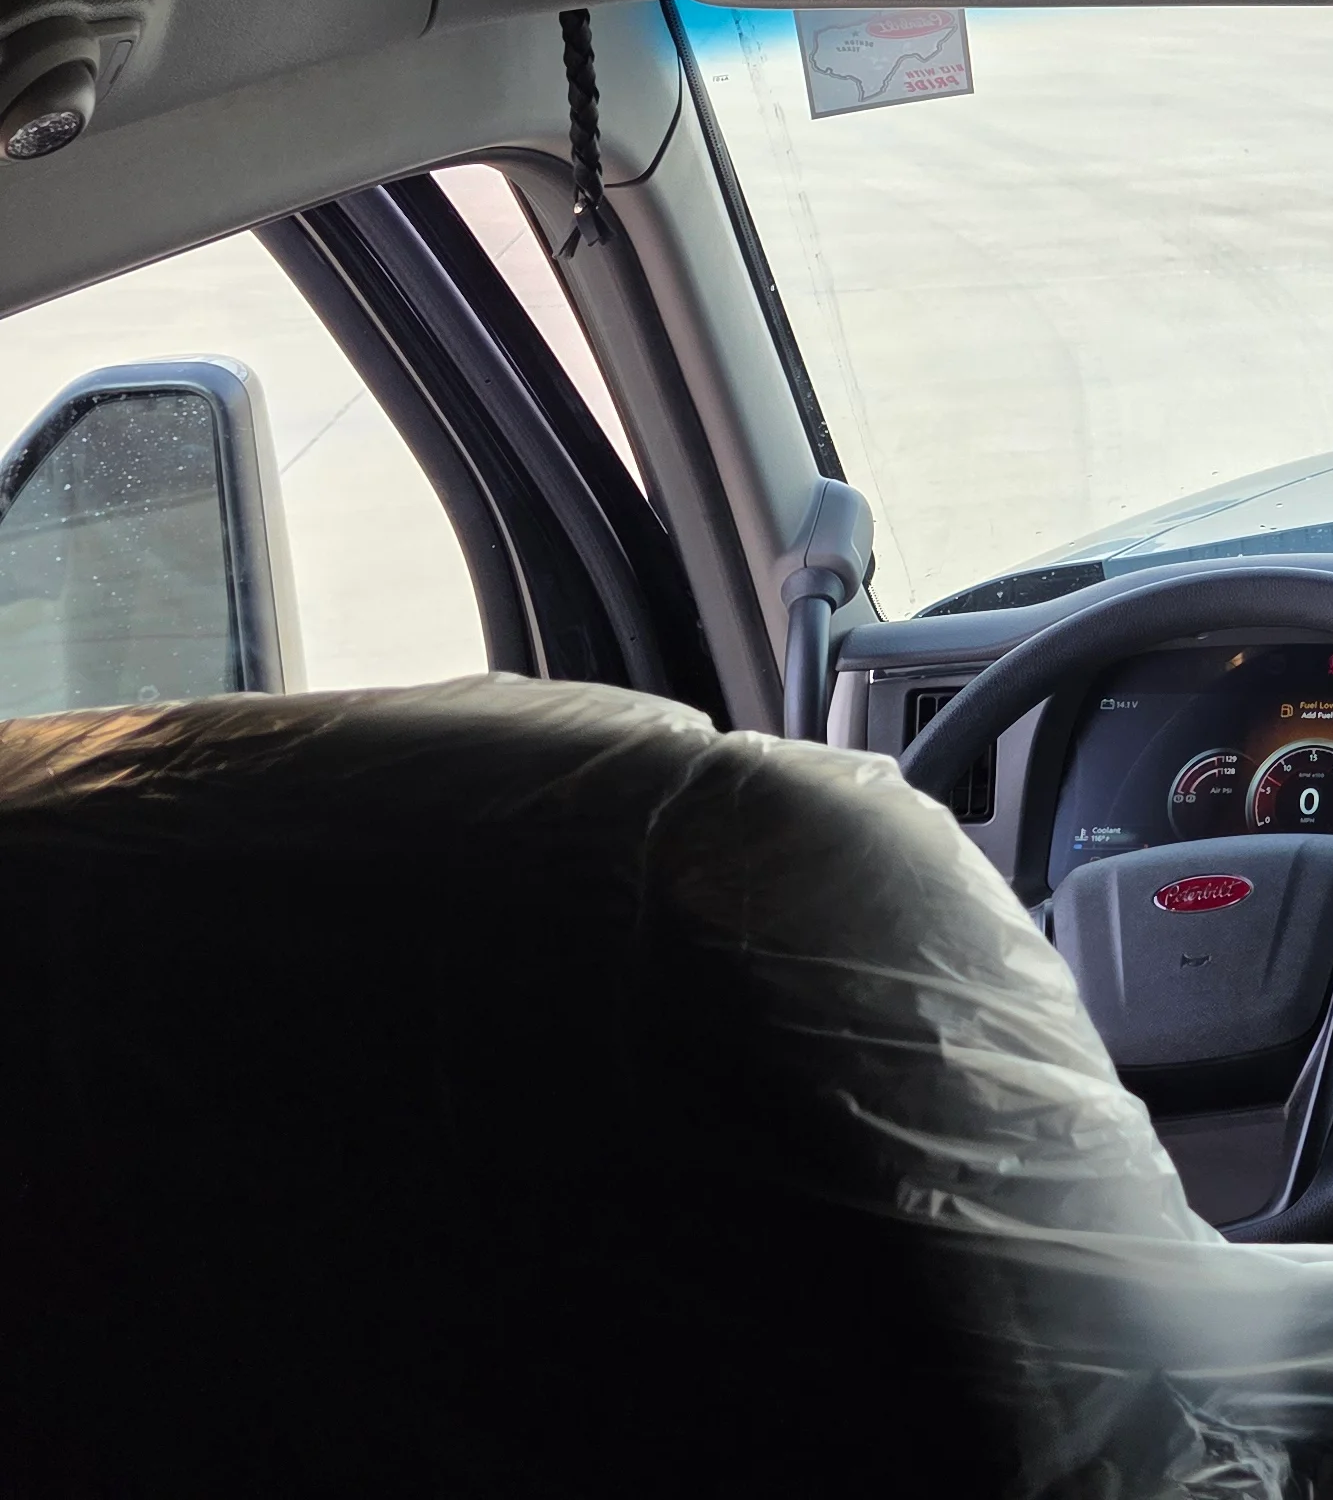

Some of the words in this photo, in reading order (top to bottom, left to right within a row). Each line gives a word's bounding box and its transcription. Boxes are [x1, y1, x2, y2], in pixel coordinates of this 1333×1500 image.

[1300, 701, 1318, 709] Fuel
[1283, 764, 1292, 772] 10
[1299, 787, 1320, 815] 0
[1092, 826, 1121, 834] Coolant
[1165, 880, 1243, 905] Peterbilt
